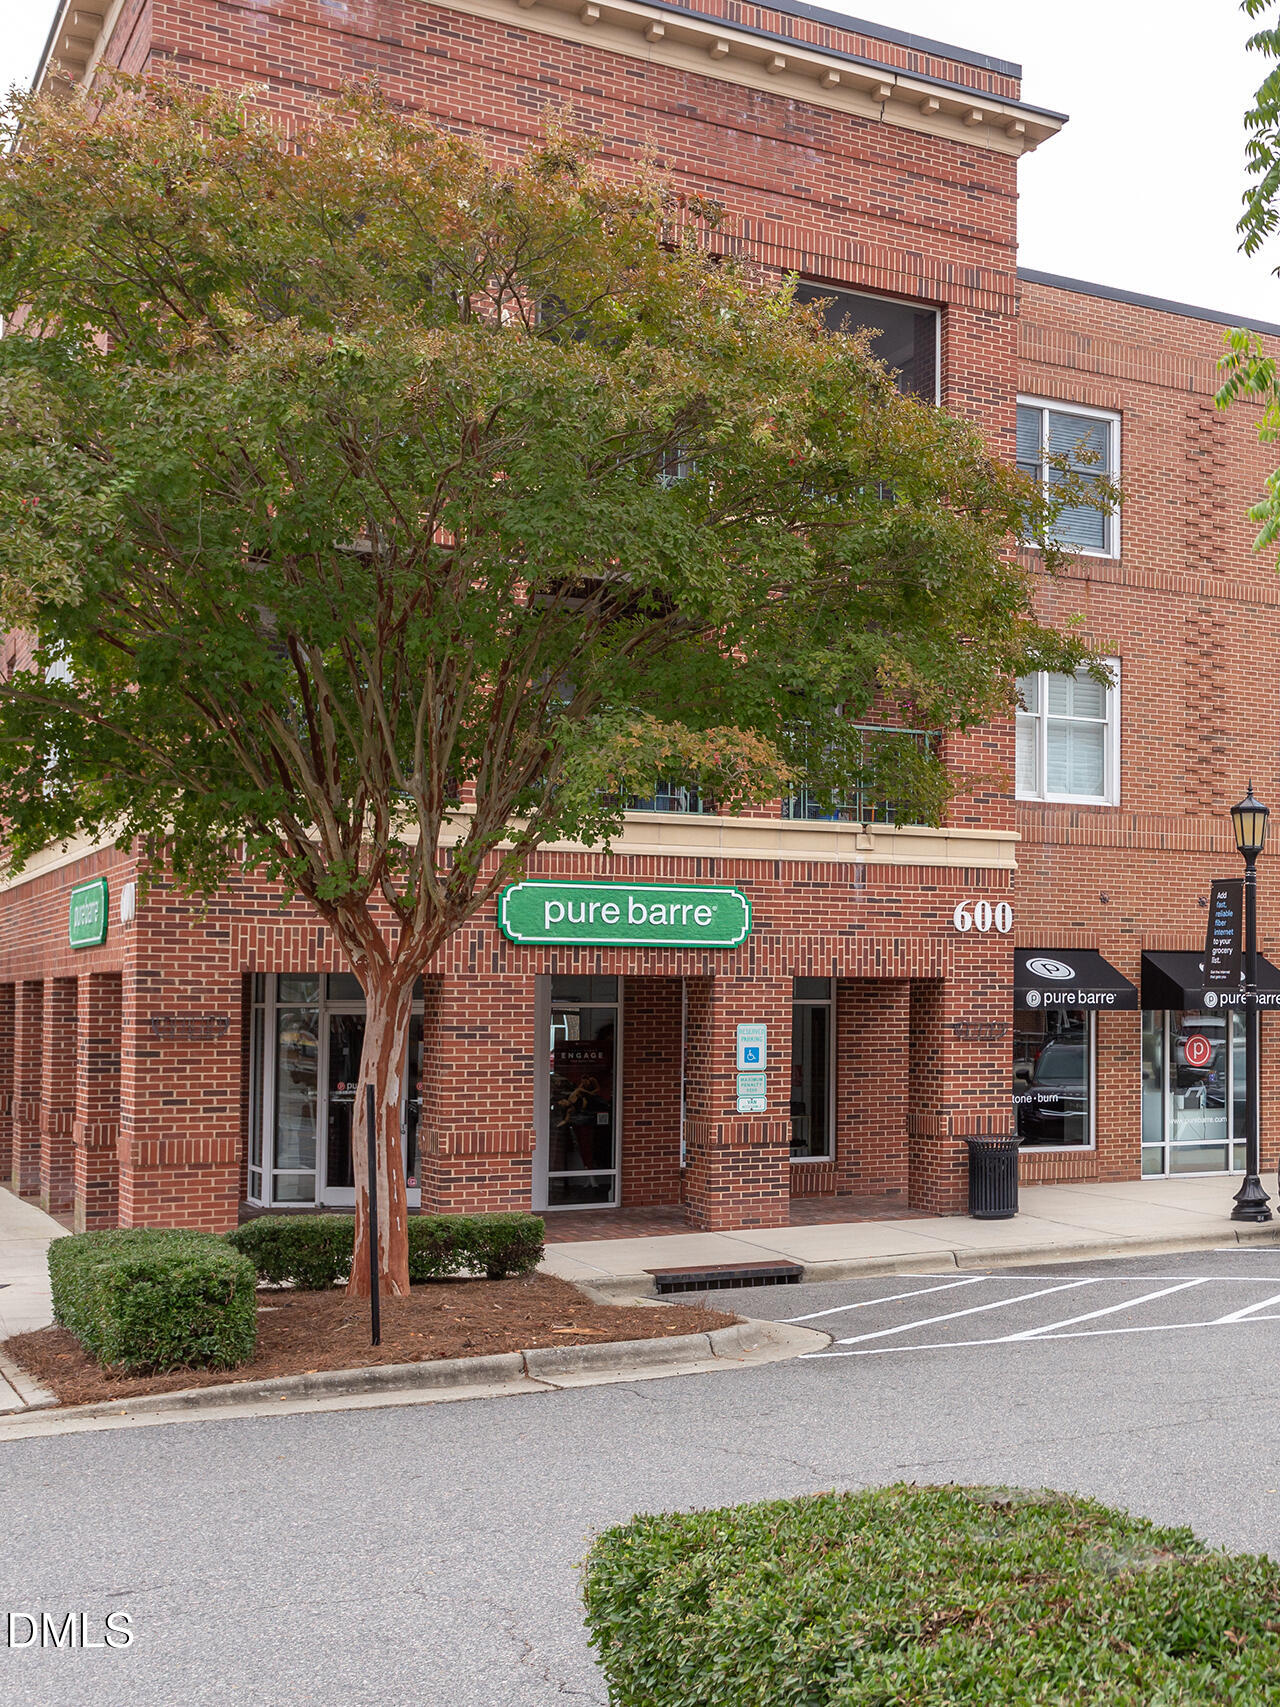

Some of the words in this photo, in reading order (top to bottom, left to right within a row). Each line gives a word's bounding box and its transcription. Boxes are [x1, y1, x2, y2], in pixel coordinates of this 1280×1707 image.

[1216, 891, 1228, 899] Add
[544, 900, 620, 930] pure
[953, 899, 1013, 934] 600
[1215, 909, 1234, 917] reliable
[1214, 919, 1227, 927] fiber
[1214, 928, 1234, 936] internet
[1219, 938, 1232, 946] your
[1211, 947, 1233, 956] grocery
[1043, 992, 1076, 1007] pure
[1220, 993, 1246, 1007] pure
[1012, 1094, 1032, 1104] tone
[1037, 1093, 1059, 1103] burn
